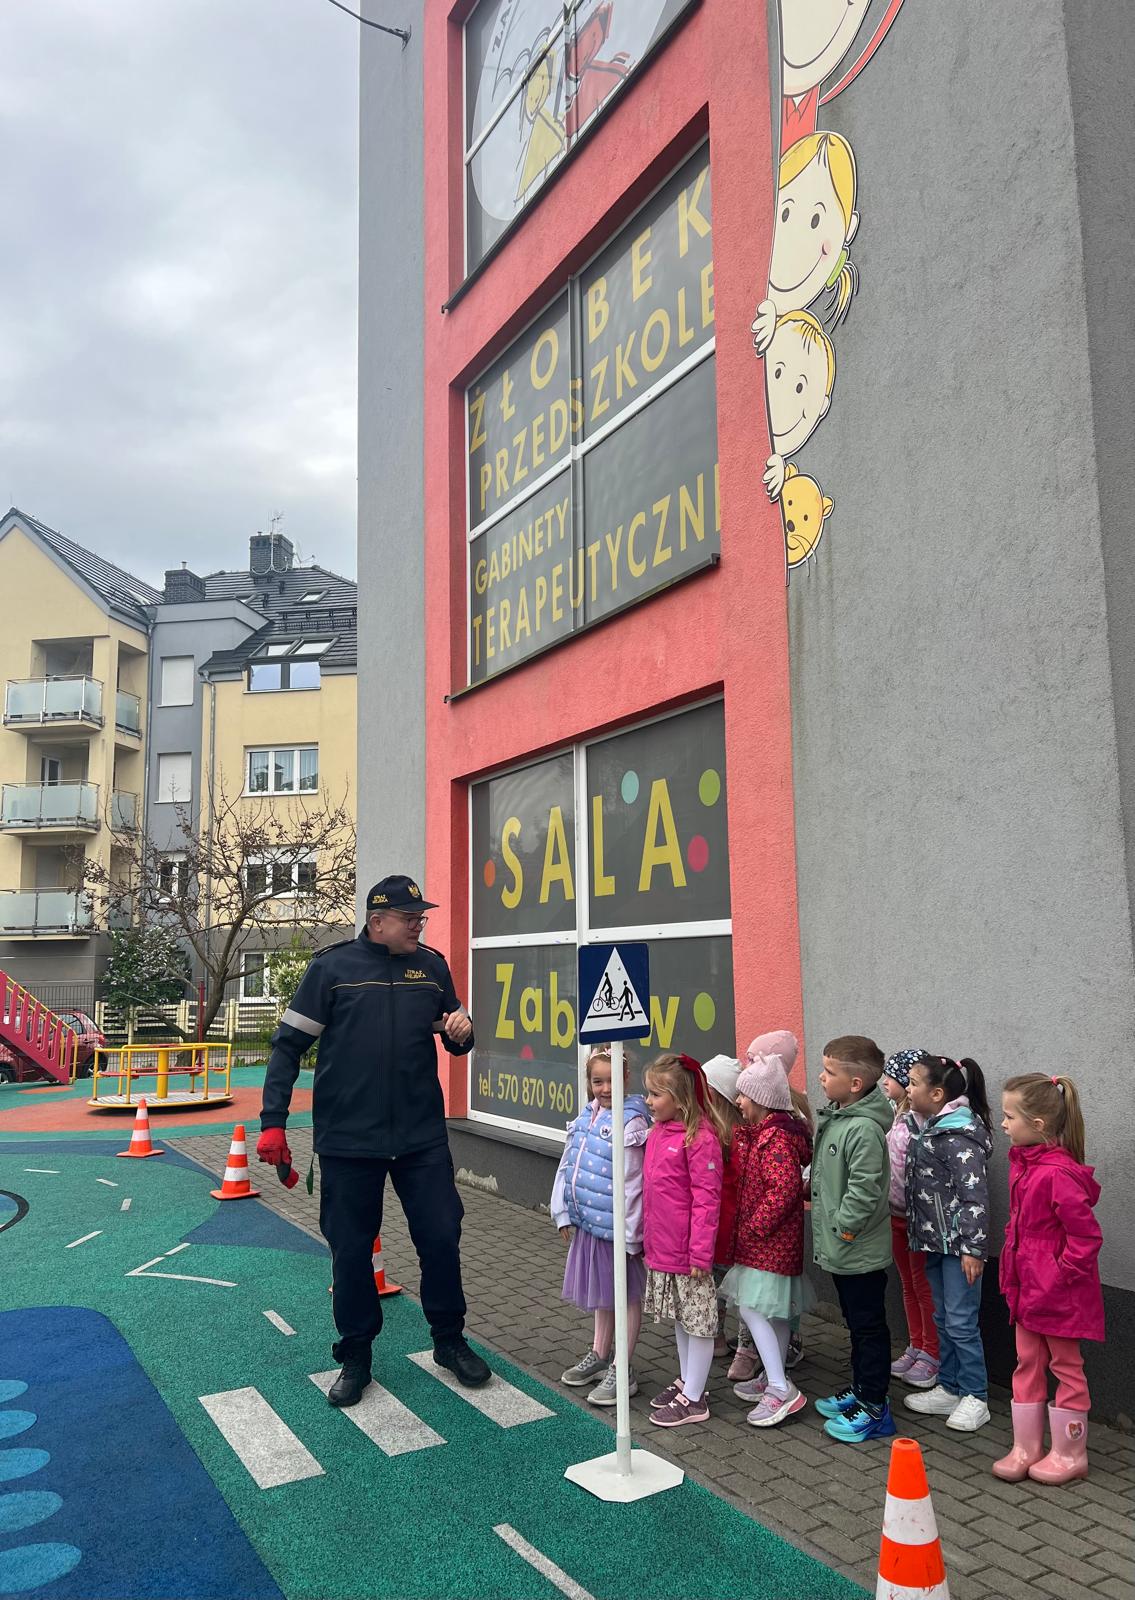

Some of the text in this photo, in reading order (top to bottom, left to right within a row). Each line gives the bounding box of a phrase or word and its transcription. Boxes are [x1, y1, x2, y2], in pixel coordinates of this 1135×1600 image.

[470, 165, 711, 454] ŻŁOBEK
[480, 261, 714, 511] PRZEDSZKOLE
[475, 497, 569, 594] GABINETY
[501, 778, 687, 909] SALA
[495, 963, 680, 1049] Zabw
[478, 1069, 574, 1114] tel. 570 870 960
